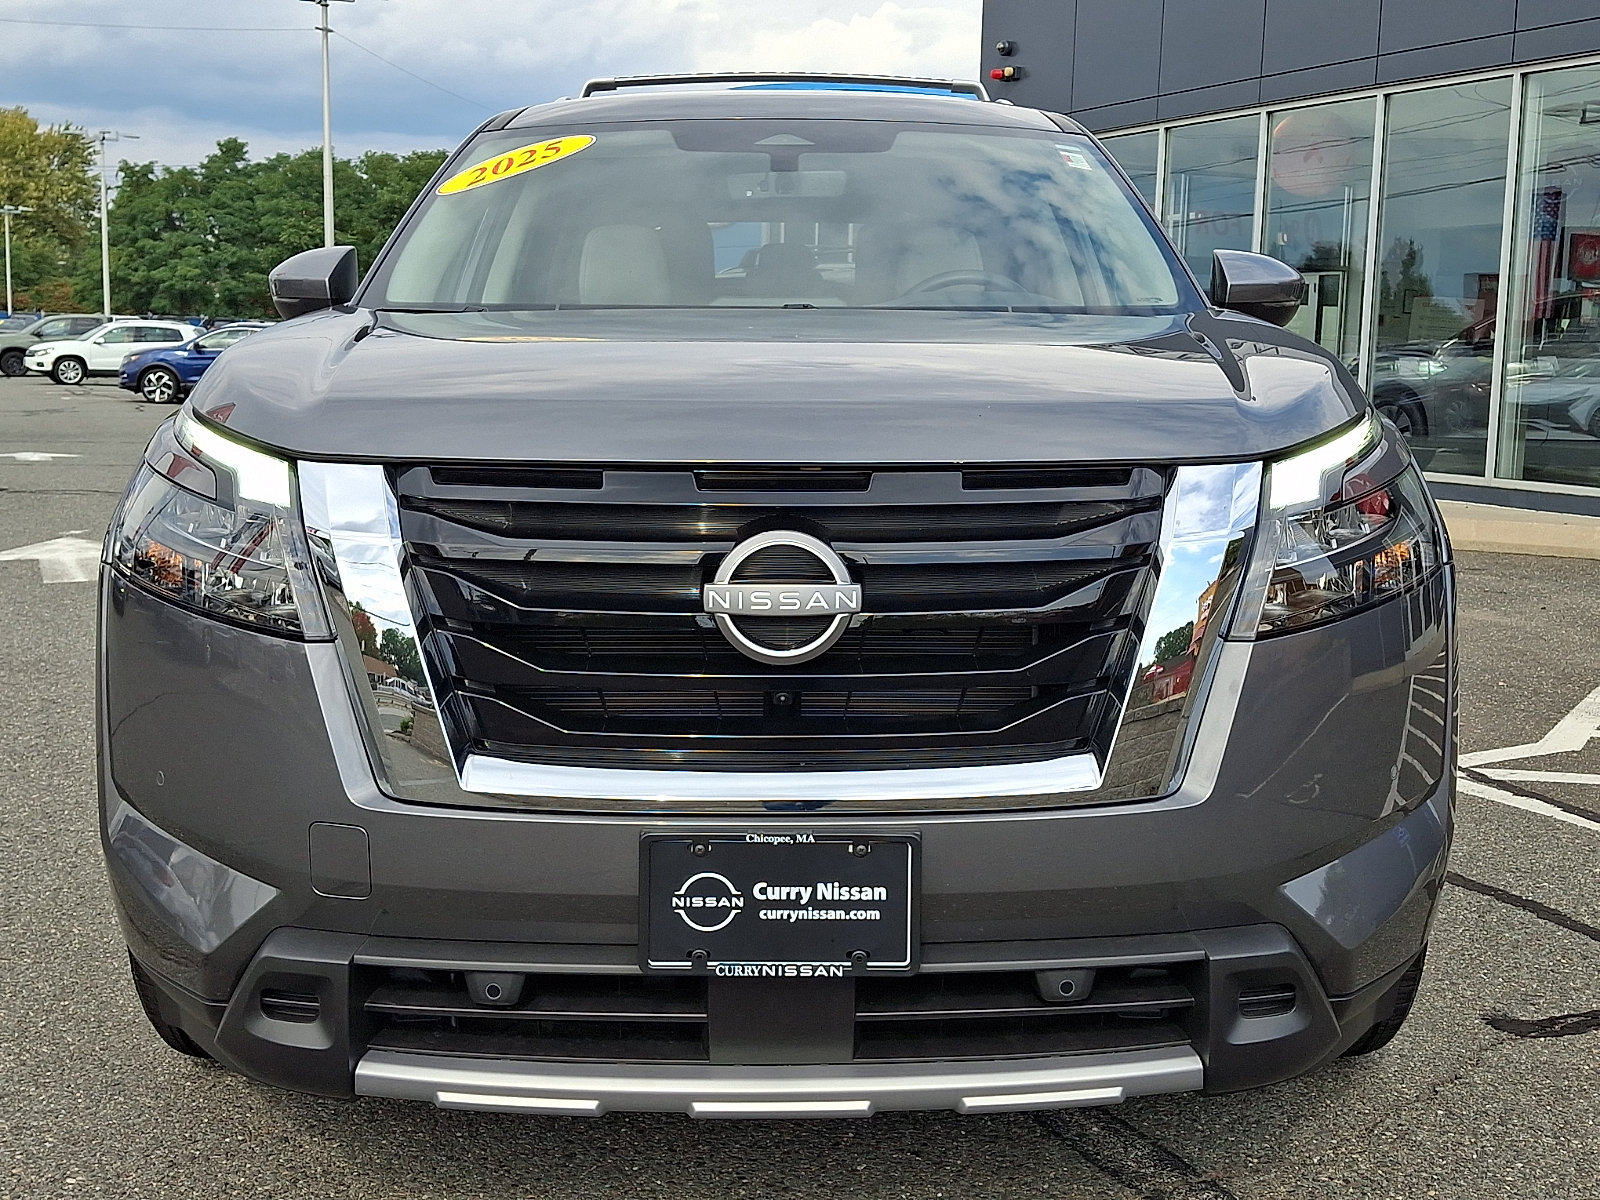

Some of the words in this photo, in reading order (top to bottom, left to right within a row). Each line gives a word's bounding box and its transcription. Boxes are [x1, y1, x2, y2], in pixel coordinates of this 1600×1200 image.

[467, 140, 562, 187] 2025
[708, 590, 857, 610] NISSAN
[746, 834, 793, 845] Chicopee,
[796, 834, 815, 843] MA
[672, 897, 744, 907] NISSAN
[752, 882, 813, 905] Curry
[817, 882, 887, 901] Nissan
[759, 907, 881, 922] currynissan.com
